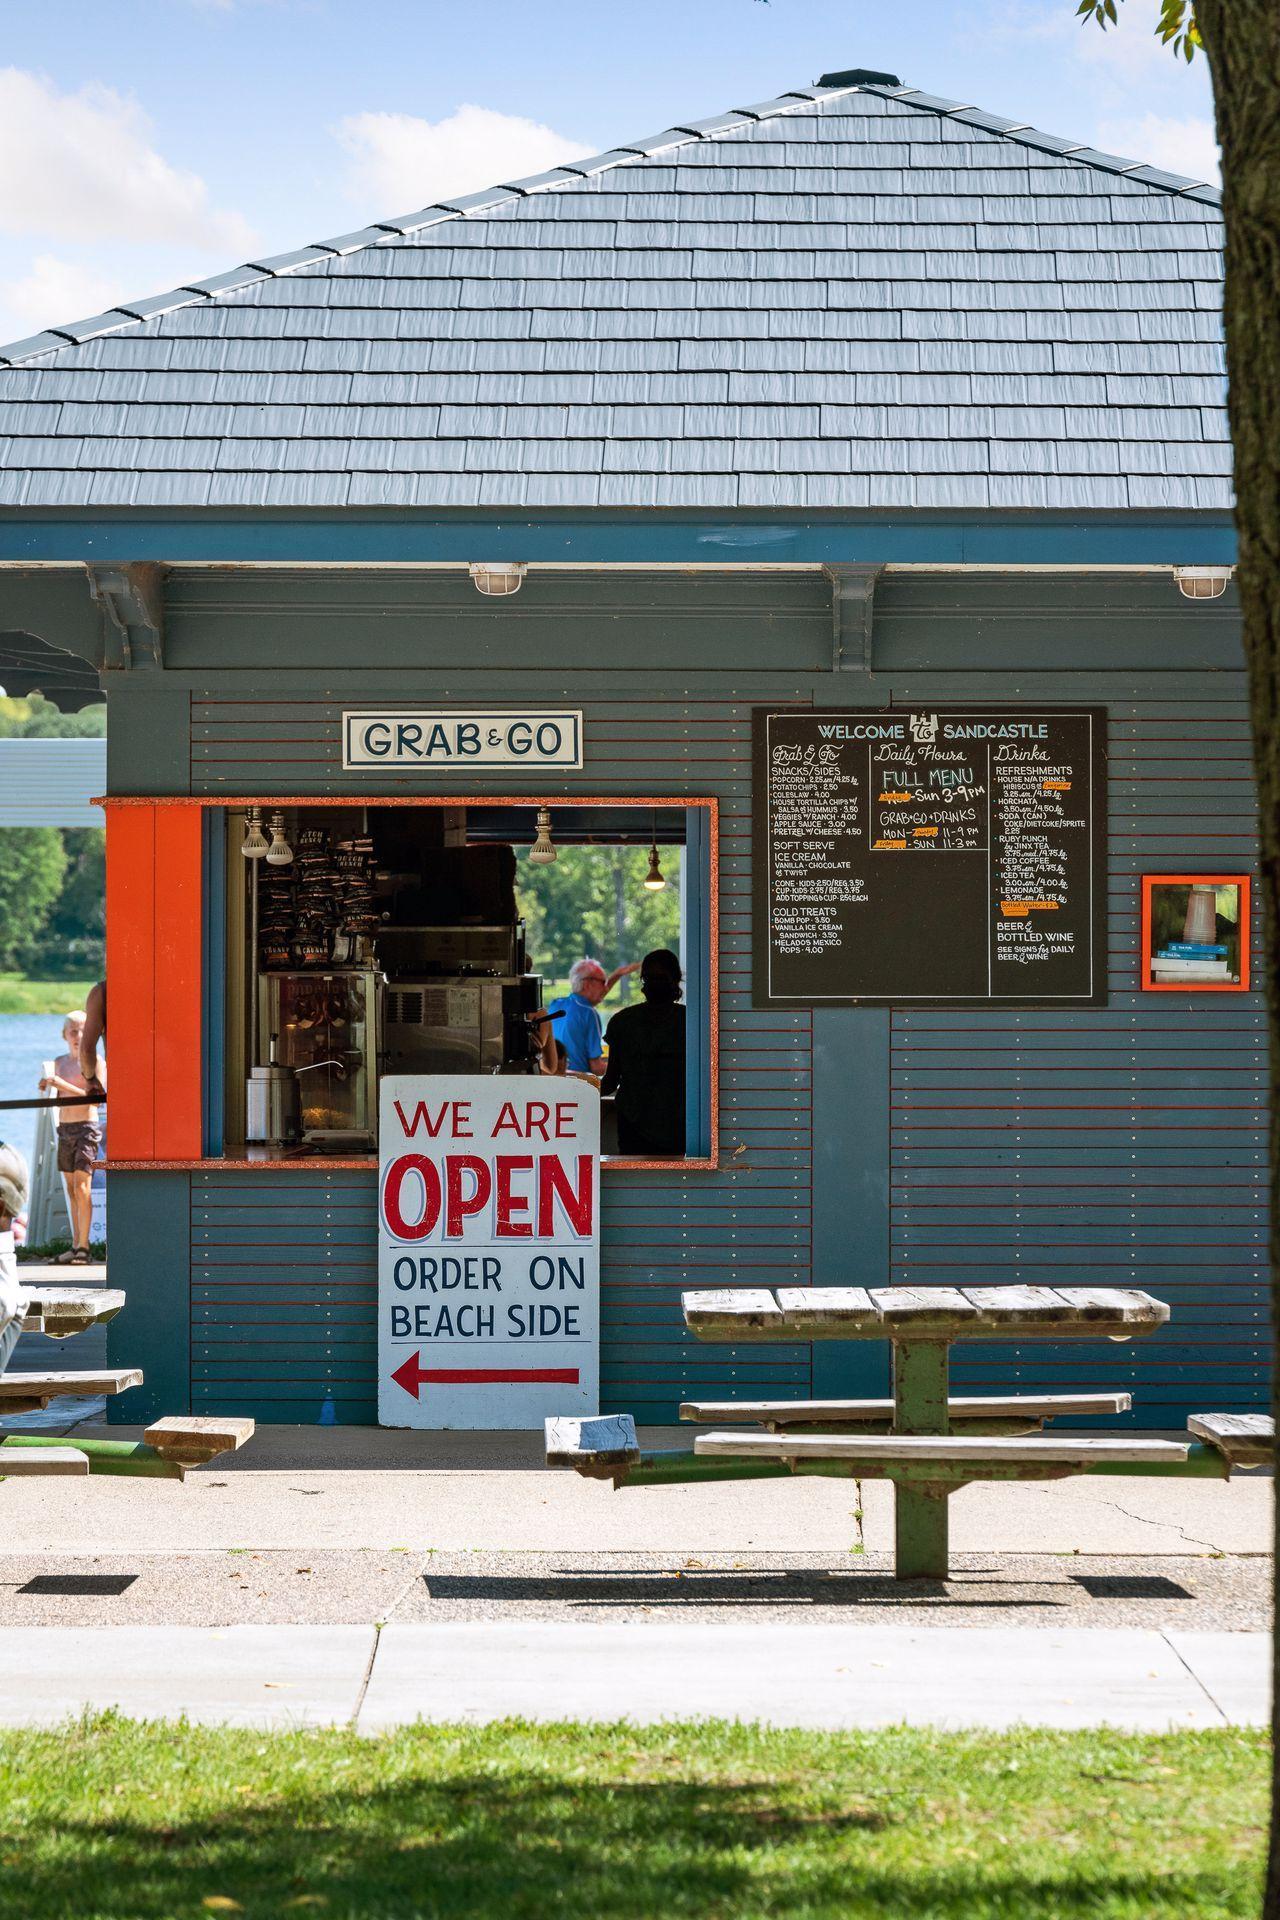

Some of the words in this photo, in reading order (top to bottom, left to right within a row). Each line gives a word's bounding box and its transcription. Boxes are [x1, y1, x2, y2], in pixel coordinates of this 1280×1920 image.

[818, 725, 904, 739] WELCOME
[911, 721, 934, 740] to
[943, 724, 1048, 739] SANDCASTLE
[363, 723, 482, 757] GRAB
[488, 729, 504, 747] &
[507, 722, 562, 756] GO
[772, 744, 803, 766] Grab
[803, 744, 819, 766] &
[819, 744, 844, 766] Go
[874, 743, 918, 766] Daily
[918, 744, 967, 761] Hours
[993, 743, 1051, 761] Drinks
[771, 766, 841, 776] SNACKS/SIDES
[995, 766, 1073, 775] REFRESHMENTS
[883, 770, 923, 789] FULL
[929, 768, 973, 786] MENU
[823, 783, 838, 791] 2.50
[773, 813, 803, 821] VEGGIES
[840, 813, 857, 821] 4.00
[774, 828, 806, 837] PRETZEL
[966, 827, 979, 835] PM
[999, 835, 1021, 843] RUBY
[773, 841, 800, 850] SOFT
[802, 841, 835, 850] SERVE
[774, 853, 790, 861] ICE
[791, 853, 826, 861] CREAM
[773, 908, 798, 916] COLD
[800, 907, 837, 916] TREATS
[997, 922, 1024, 931] BEER
[1025, 921, 1033, 933] &
[997, 933, 1043, 942] BOTTLED
[1045, 933, 1074, 942] WINE
[1051, 945, 1075, 953] DAILY
[393, 1100, 474, 1138] WE
[491, 1101, 578, 1142] ARE
[383, 1154, 593, 1240] OPEN
[393, 1256, 502, 1293] ORDER
[529, 1255, 585, 1291] ON
[391, 1305, 495, 1337] BEACH
[508, 1305, 581, 1337] SIDE
